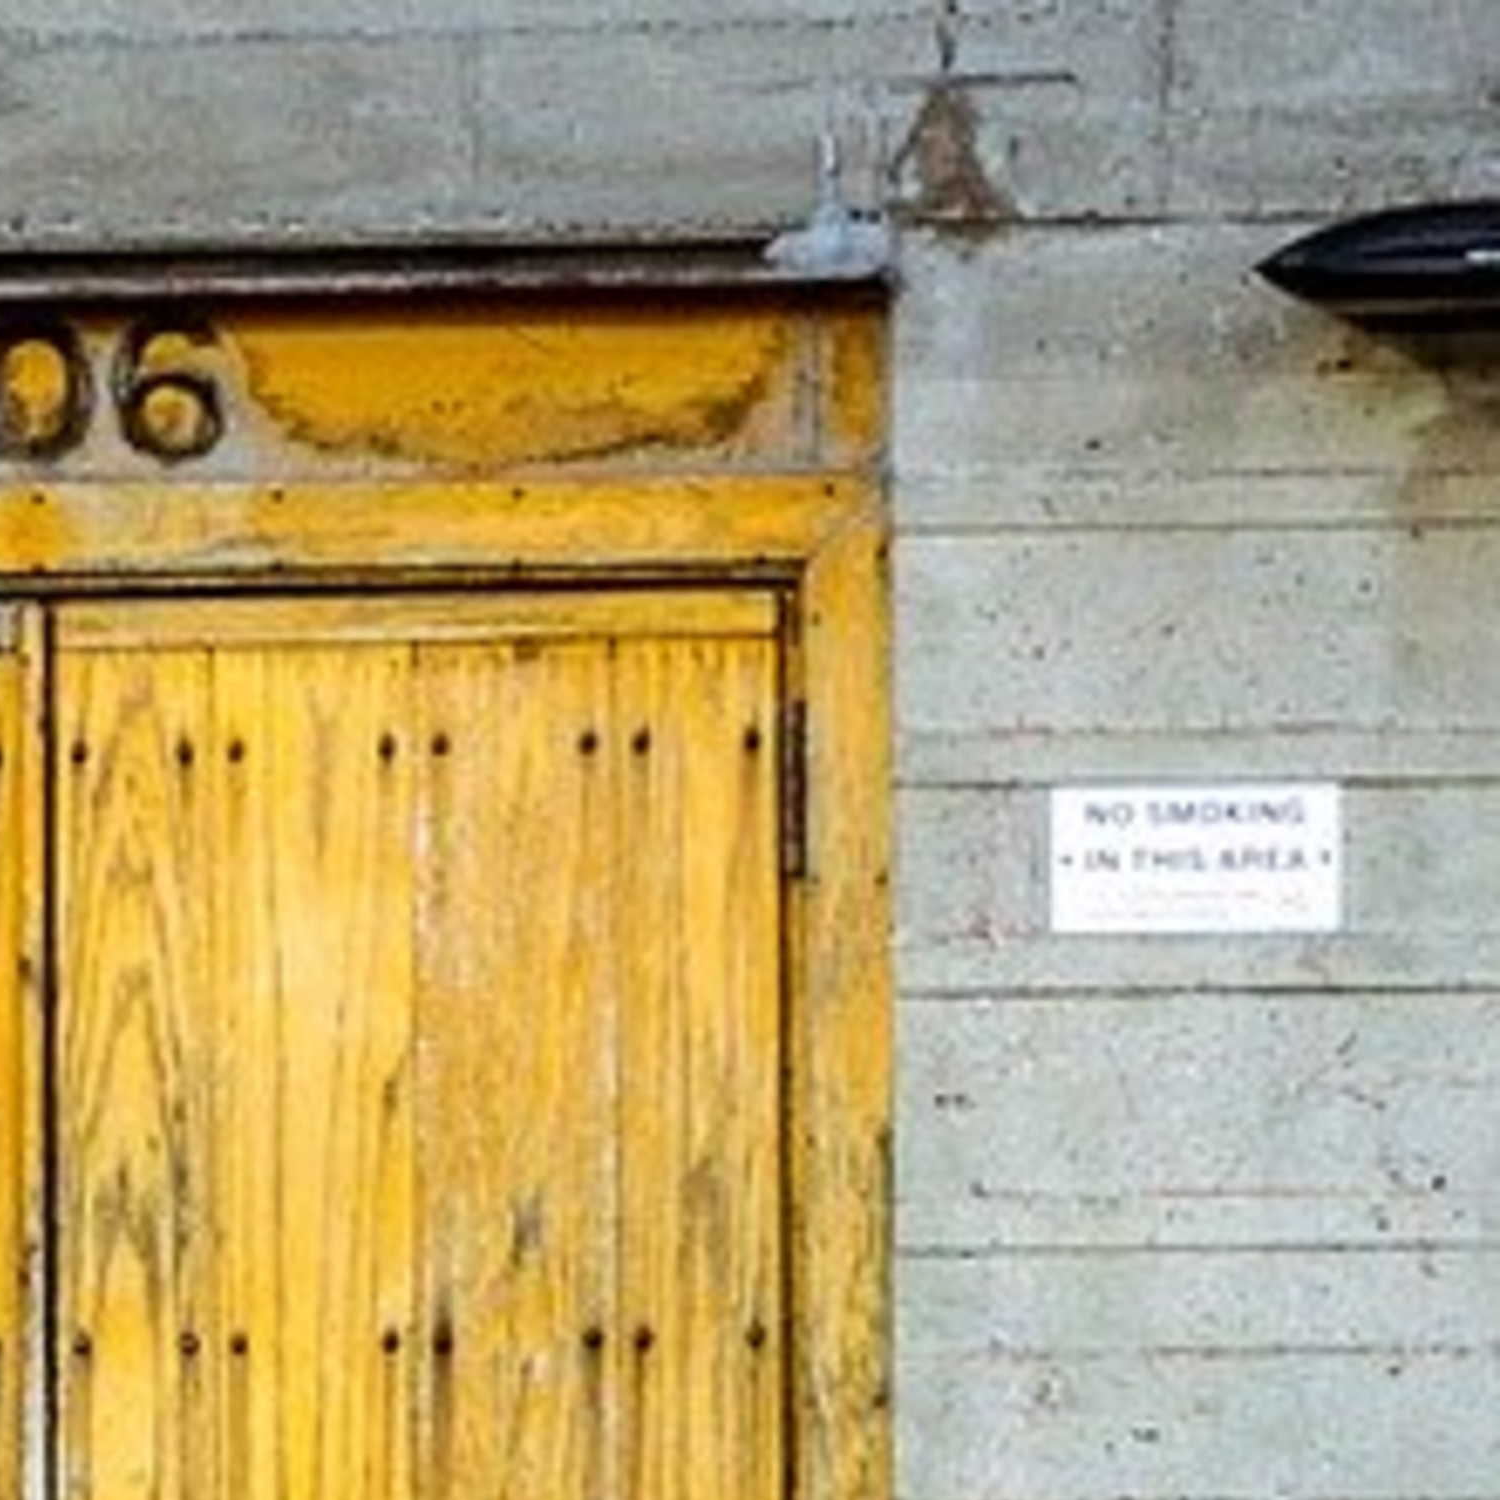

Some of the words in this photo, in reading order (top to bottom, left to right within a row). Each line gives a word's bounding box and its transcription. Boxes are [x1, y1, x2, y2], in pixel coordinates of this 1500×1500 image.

[1084, 800, 1134, 827] NO
[1145, 799, 1305, 826] SMOKING
[1084, 848, 1120, 872] IN
[1131, 848, 1207, 872] THIS
[1219, 848, 1309, 872] AREA
